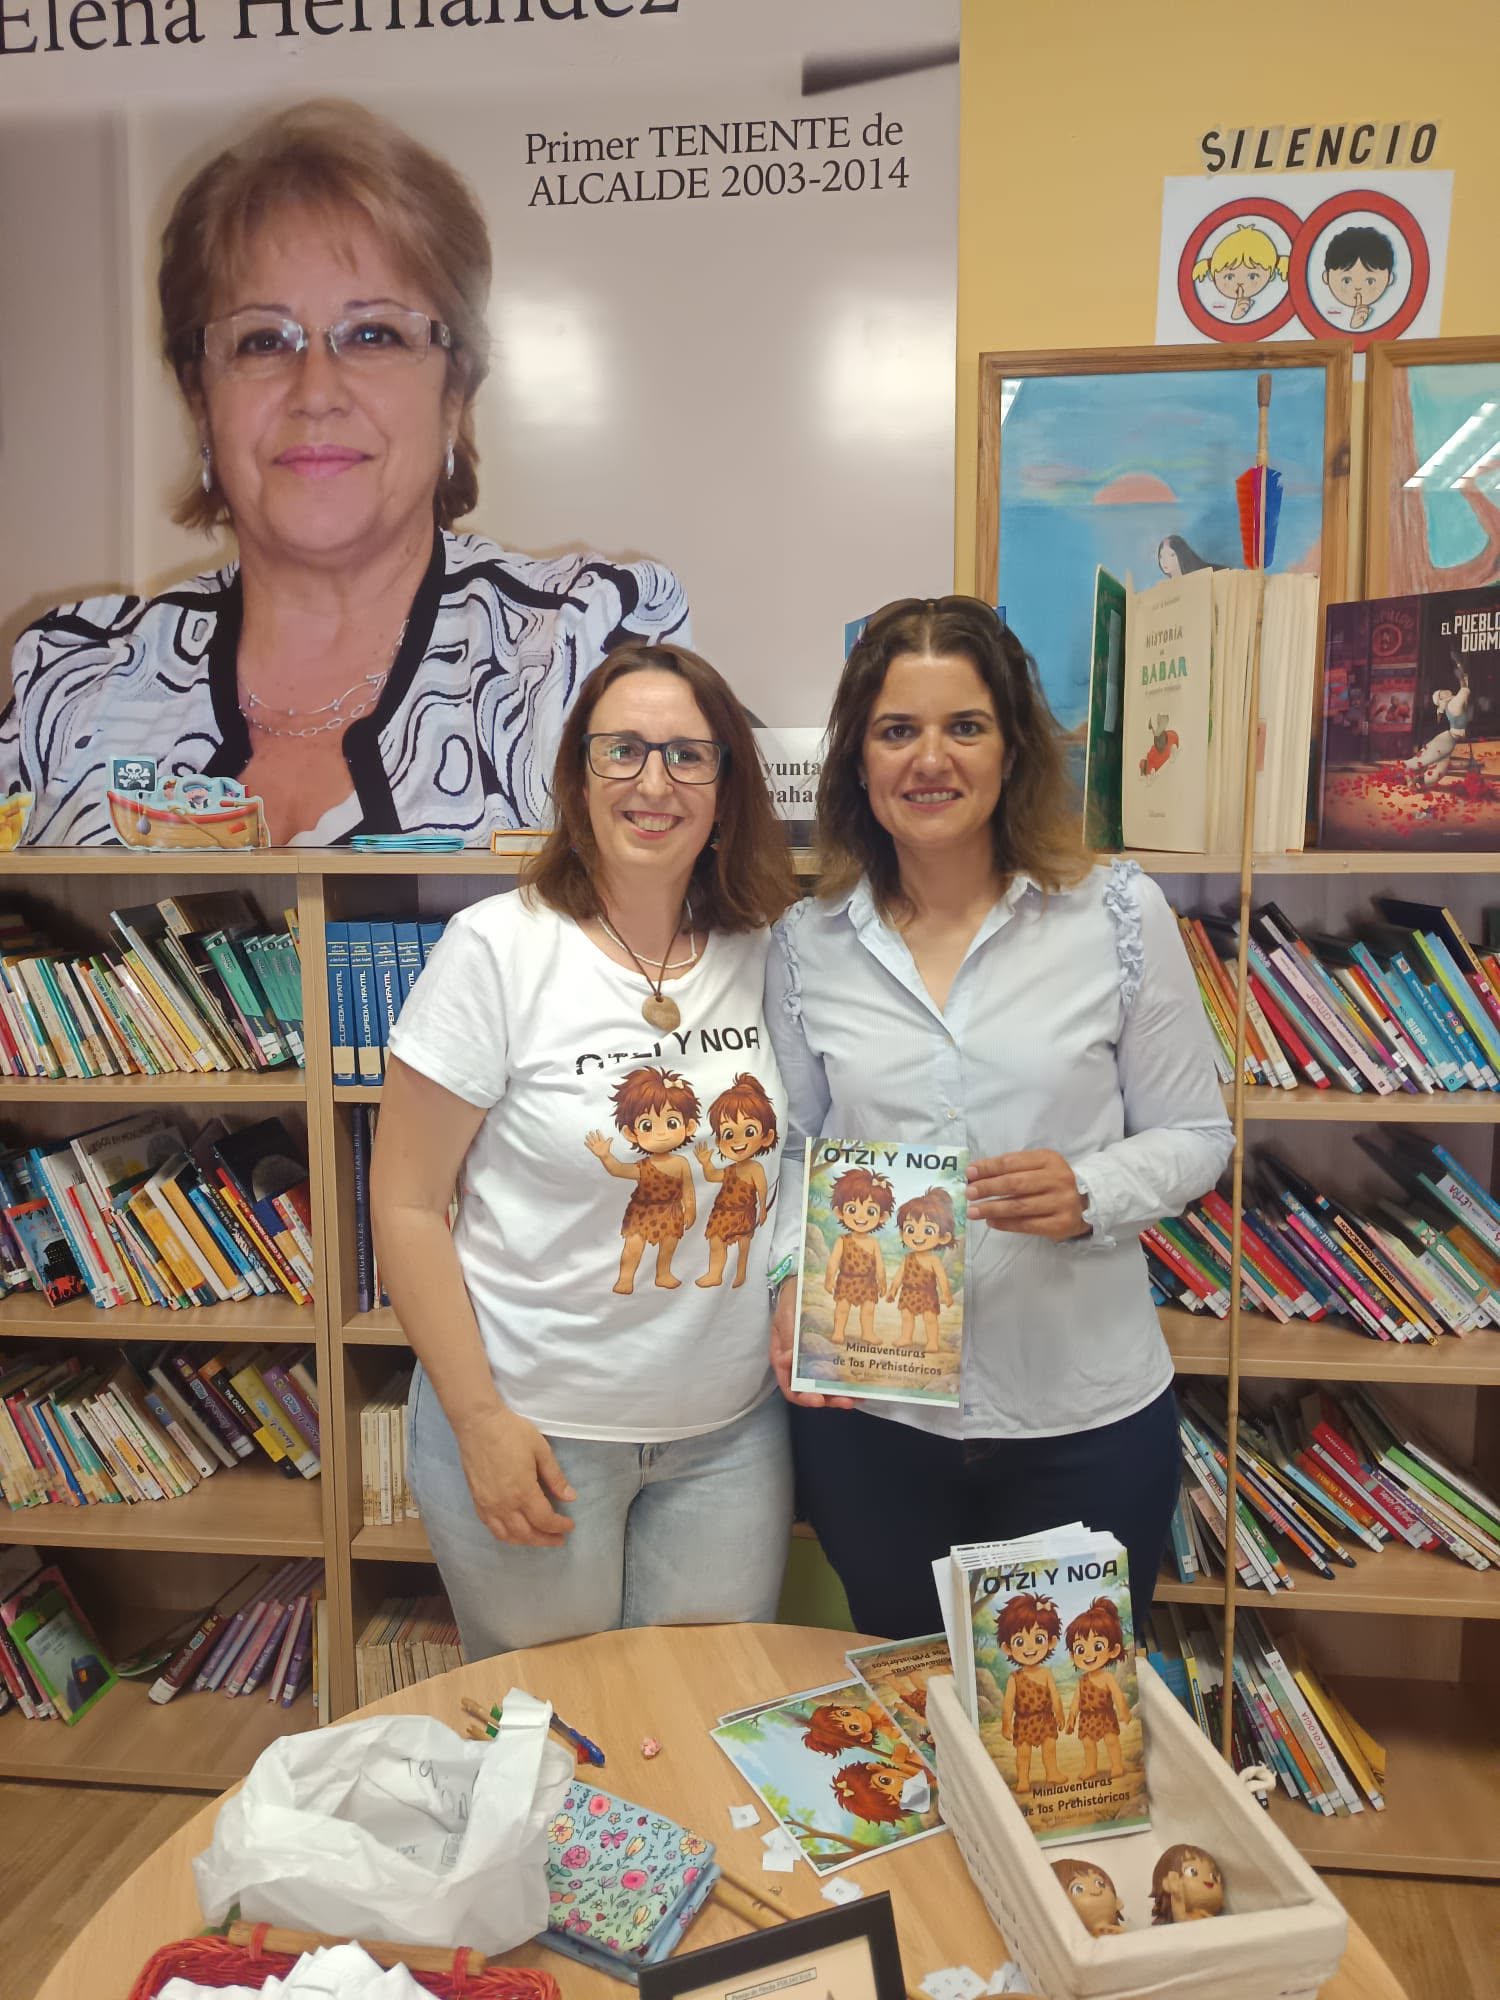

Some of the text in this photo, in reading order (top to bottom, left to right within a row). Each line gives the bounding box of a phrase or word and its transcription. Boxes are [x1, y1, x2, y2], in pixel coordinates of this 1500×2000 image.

[0, 0, 205, 53] Elena
[525, 112, 903, 164] Primer TENIENTE de
[1201, 123, 1437, 172] SILENCIO
[528, 157, 910, 207] ALCALDE 2003-2014
[1441, 622, 1452, 635] EL
[672, 1030, 692, 1055] Y
[824, 1147, 957, 1171] OTZI Y NOA
[846, 1342, 926, 1358] Miniaventuras
[833, 1355, 846, 1366] de
[849, 1357, 865, 1368] los
[869, 1359, 942, 1376] Prehistóricos
[984, 1559, 1118, 1594] OTZI Y NOA
[1033, 1777, 1113, 1799] Miniaventuras
[1038, 1803, 1053, 1815] los
[1058, 1791, 1130, 1811] Prehistóricos
